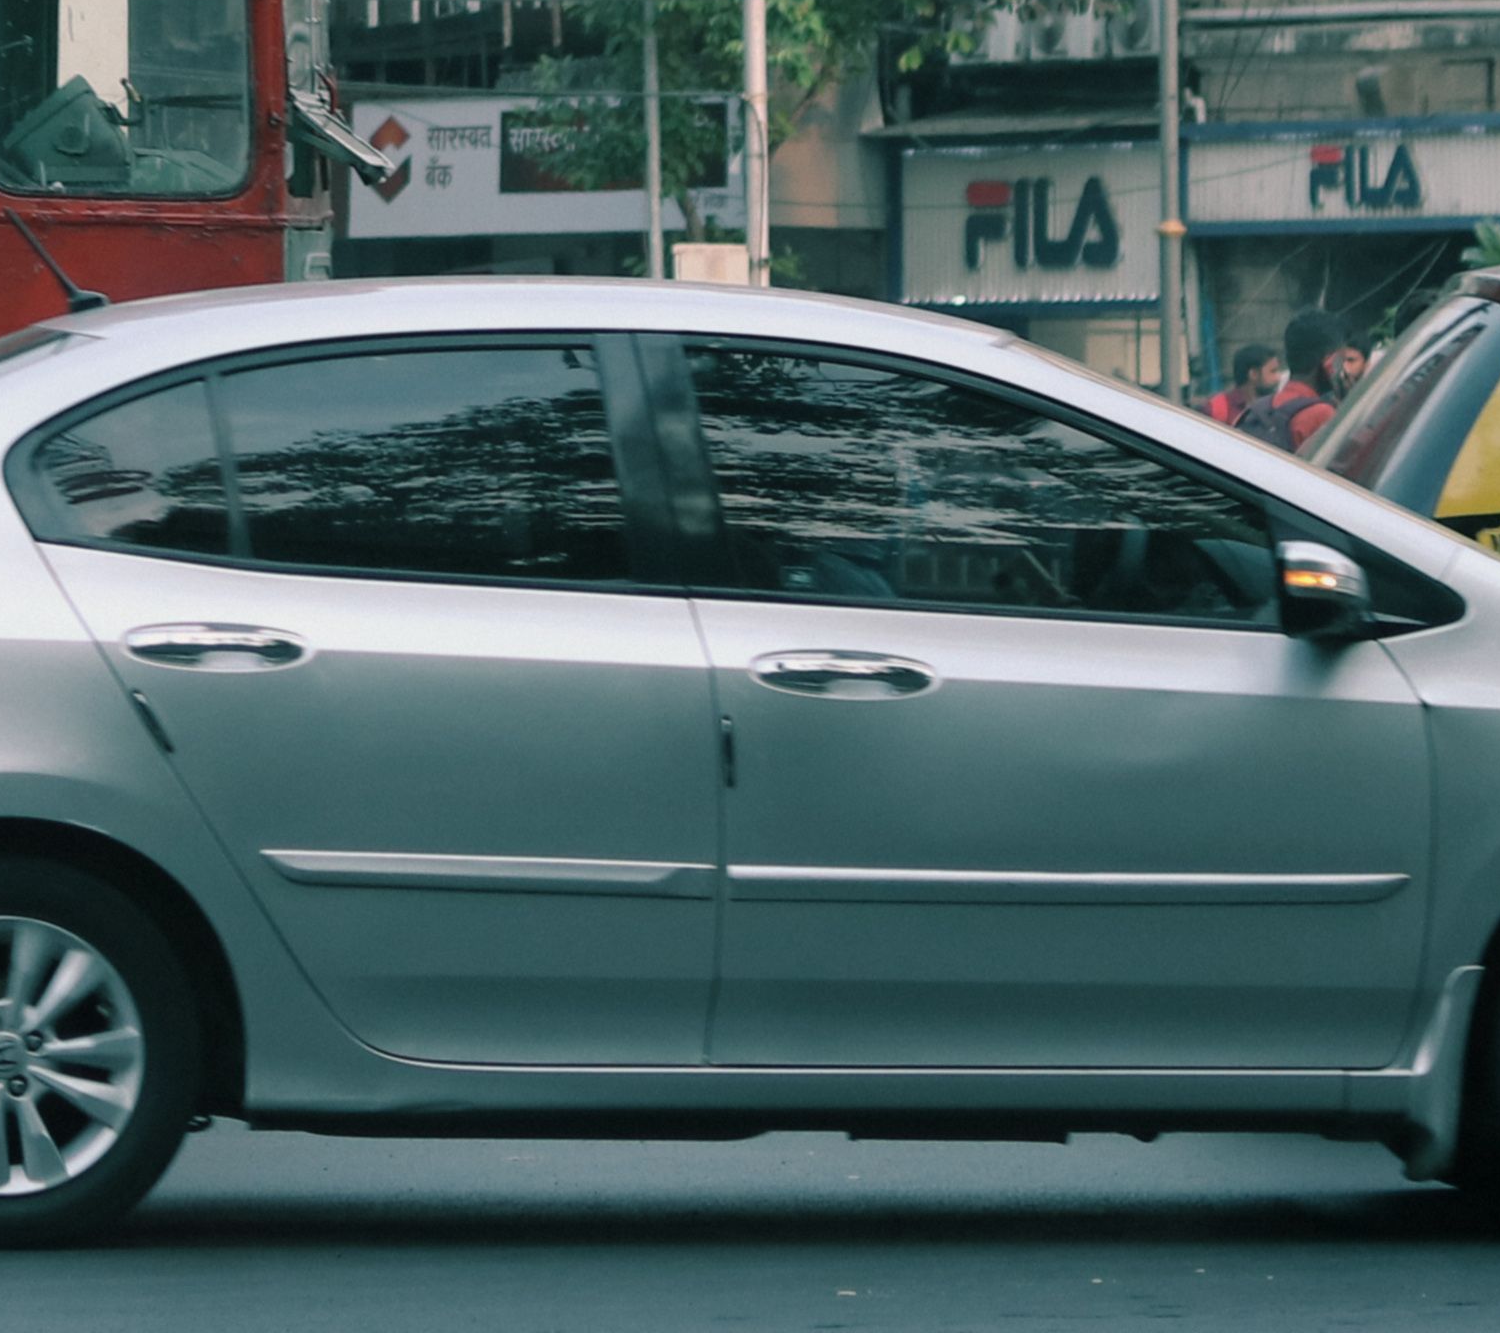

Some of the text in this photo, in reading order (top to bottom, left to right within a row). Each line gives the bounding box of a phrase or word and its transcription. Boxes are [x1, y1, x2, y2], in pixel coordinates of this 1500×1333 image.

[427, 125, 493, 151] सारस्वत
[1308, 143, 1422, 212] FILA
[965, 175, 1121, 271] FILA
